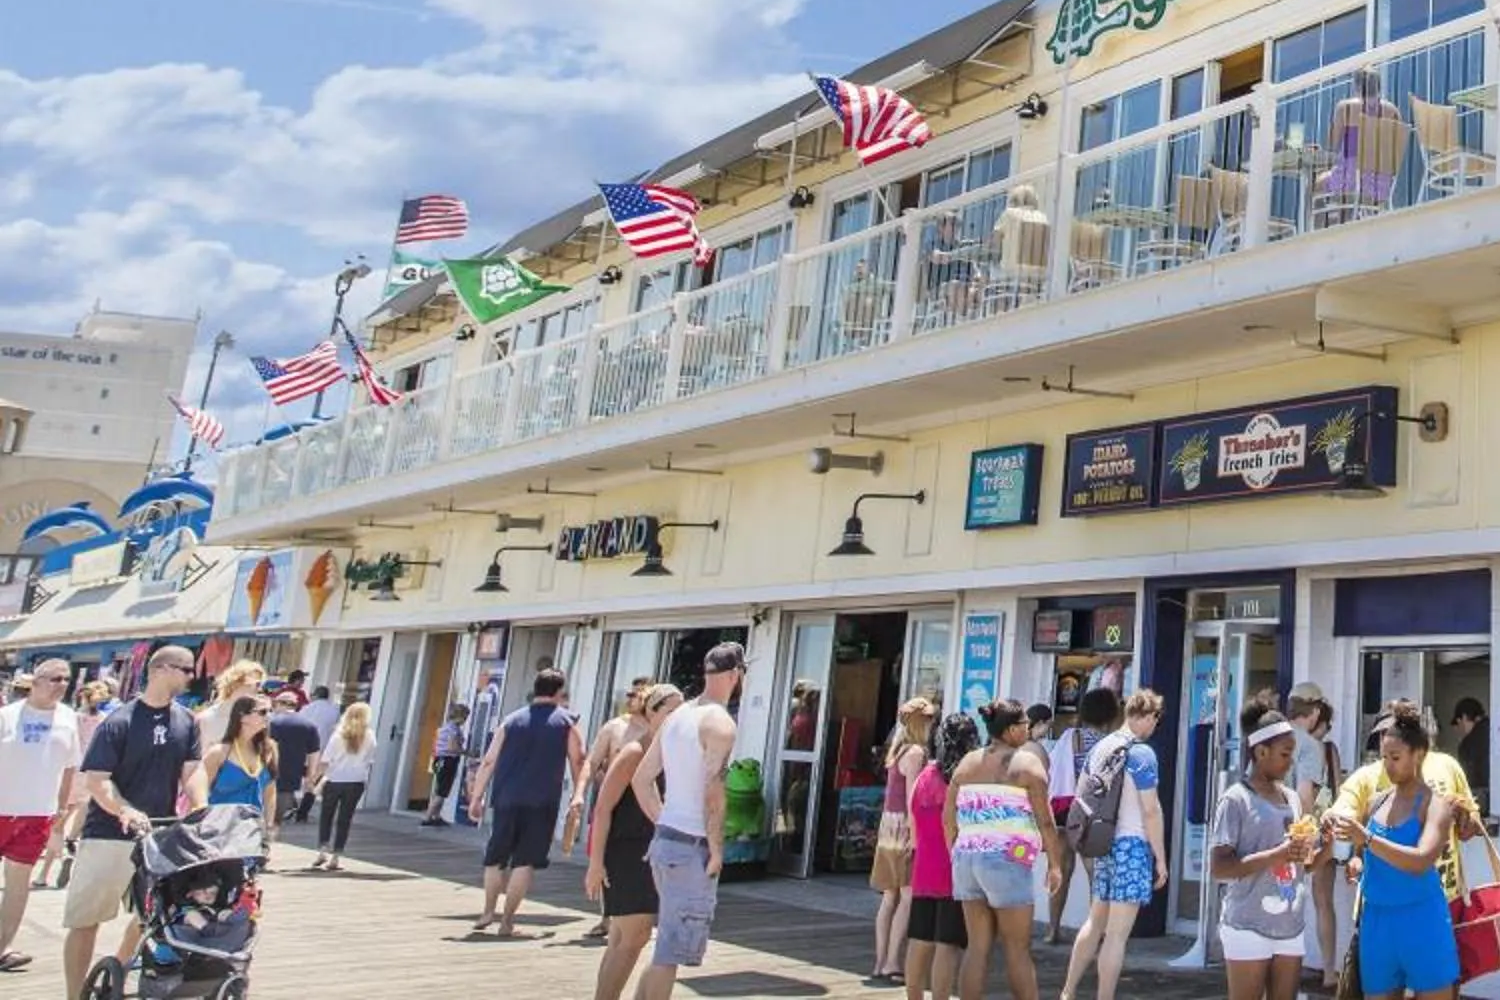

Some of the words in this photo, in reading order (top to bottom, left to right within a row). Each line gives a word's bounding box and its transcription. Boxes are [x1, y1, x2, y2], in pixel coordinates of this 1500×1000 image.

[2, 347, 27, 357] star
[33, 347, 48, 360] of
[52, 349, 74, 362] the
[77, 354, 102, 364] sea
[1093, 443, 1128, 462] IDAHO
[1224, 430, 1300, 453] Thrasher's
[1083, 459, 1136, 480] POTATOES
[1223, 456, 1263, 474] french
[1269, 450, 1297, 468] fries
[556, 515, 648, 560] PLAYLAND
